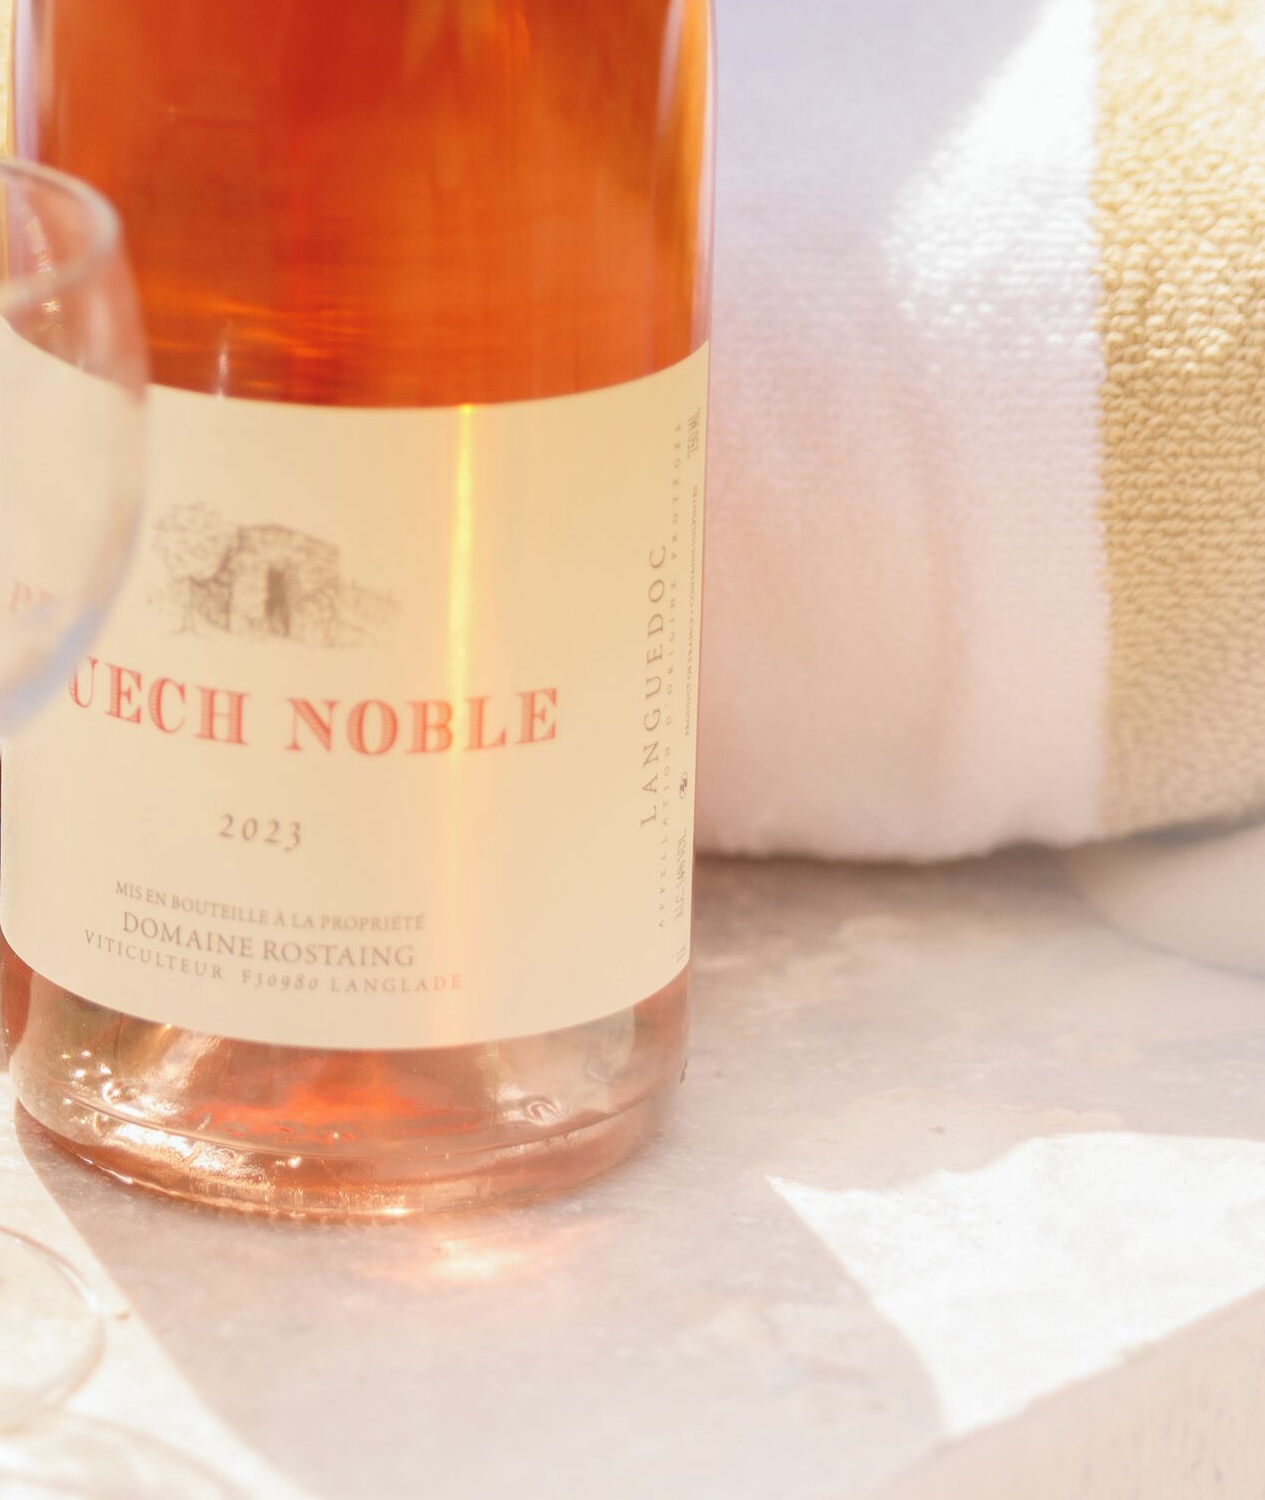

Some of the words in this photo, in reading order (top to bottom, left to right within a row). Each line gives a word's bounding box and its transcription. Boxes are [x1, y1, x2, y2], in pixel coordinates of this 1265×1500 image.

[67, 655, 249, 747] UECH
[286, 687, 558, 756] NOBLE
[640, 545, 667, 828] LANGUEDOC
[218, 813, 303, 852] 2023
[115, 880, 142, 900] MIS
[146, 889, 167, 906] EN
[171, 893, 268, 925] BOUTEILLE
[292, 913, 314, 929] LA
[85, 929, 223, 980] VITICULTEUR
[242, 968, 319, 991] F30980
[330, 973, 463, 993] LANGLADE
[122, 911, 253, 959] DOMAINE
[262, 939, 414, 967] ROSTAING
